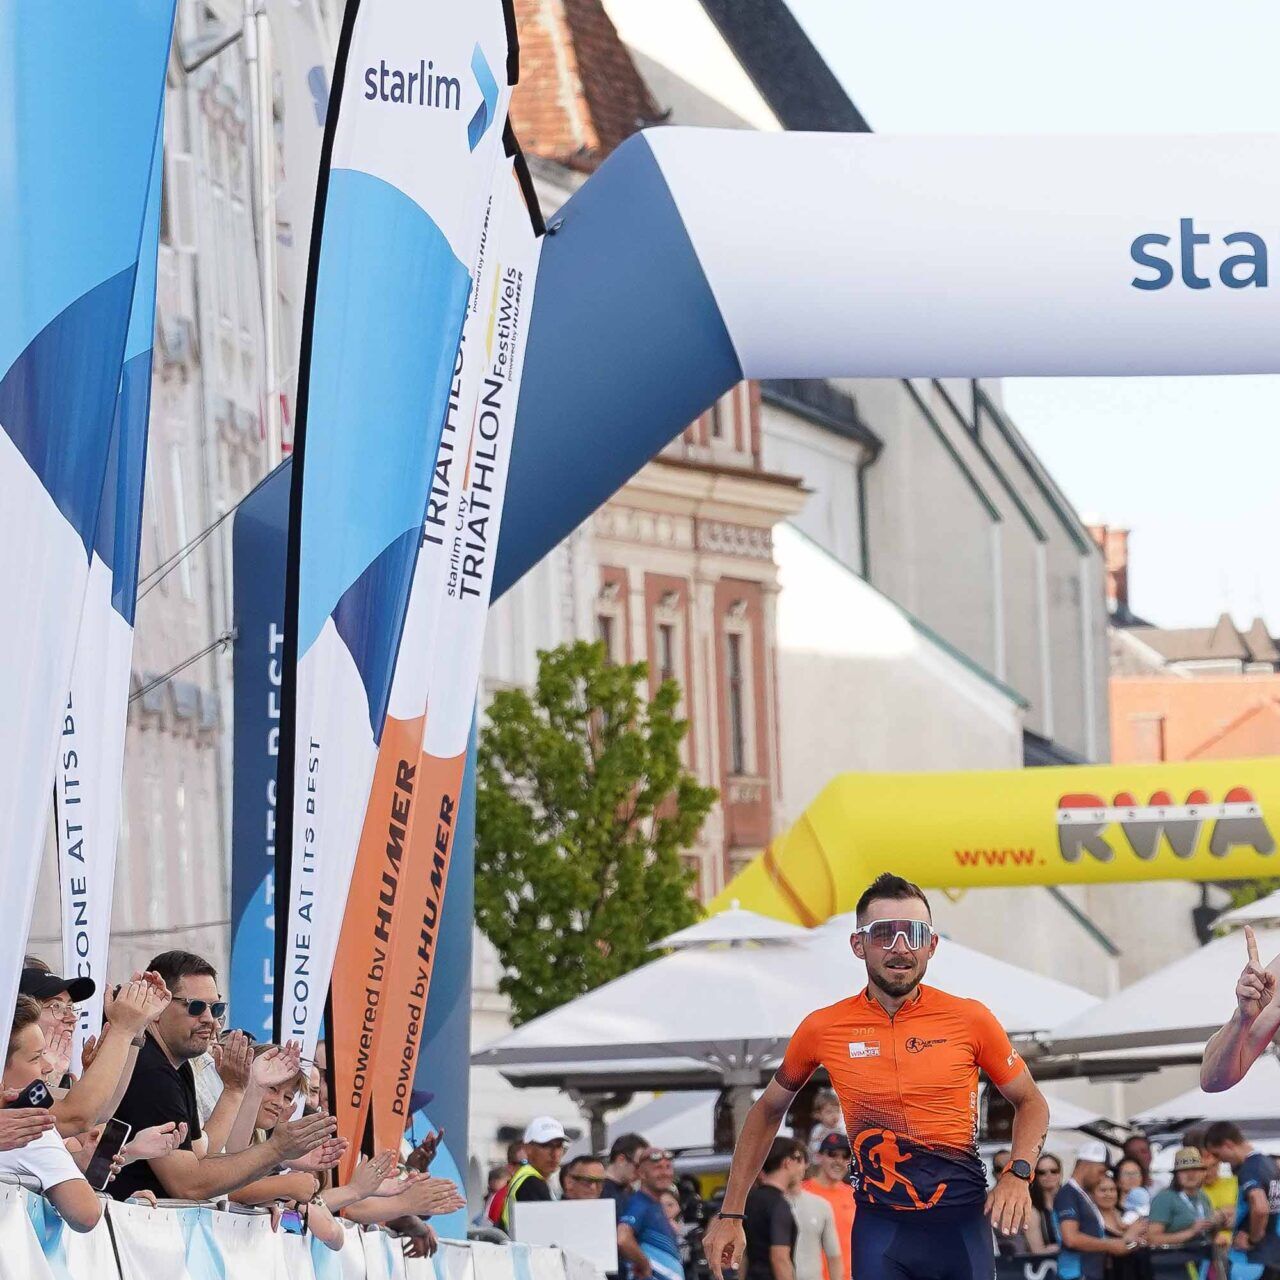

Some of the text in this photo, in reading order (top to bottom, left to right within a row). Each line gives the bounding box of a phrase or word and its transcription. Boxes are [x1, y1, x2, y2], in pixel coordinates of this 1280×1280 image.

[364, 59, 461, 111] starlim
[493, 267, 517, 379] FestiWels
[460, 378, 504, 600] TRIATHLON
[448, 495, 469, 597] starlim City
[63, 750, 82, 805] ITS
[305, 736, 321, 815] BEST
[66, 819, 85, 864] AT
[302, 827, 315, 873] ITS
[374, 758, 417, 944] HUMER
[955, 848, 1047, 867] www.
[1056, 785, 1277, 863] RWA
[299, 884, 314, 923] AT
[391, 794, 455, 1117] powered by HUMER
